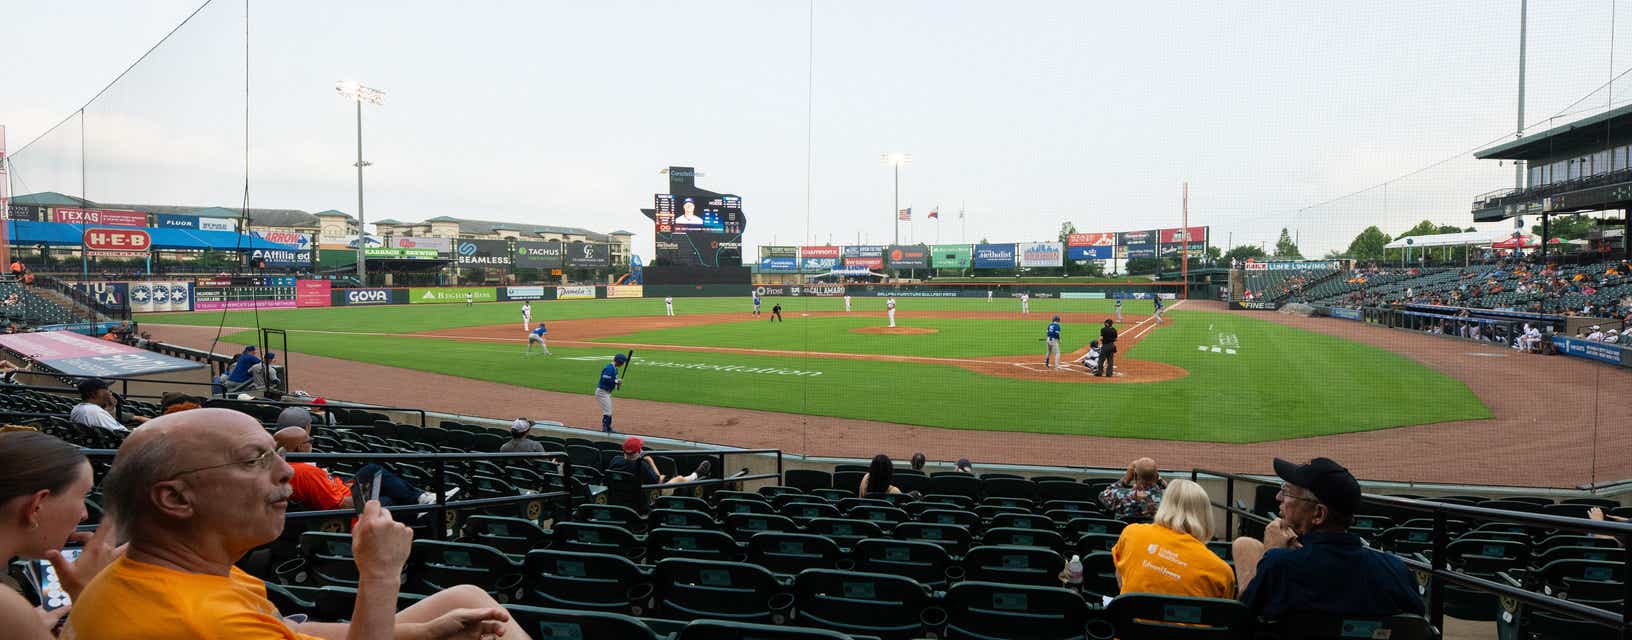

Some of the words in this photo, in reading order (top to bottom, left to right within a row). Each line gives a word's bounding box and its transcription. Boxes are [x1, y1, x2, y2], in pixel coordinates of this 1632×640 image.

[60, 210, 99, 222] TEXAS
[265, 232, 299, 243] ARROW
[264, 250, 310, 260] Affiliaed
[528, 248, 560, 256] TACHUS
[978, 250, 1012, 258] Methodist
[766, 287, 783, 295] Frost
[349, 291, 387, 303] GOYA
